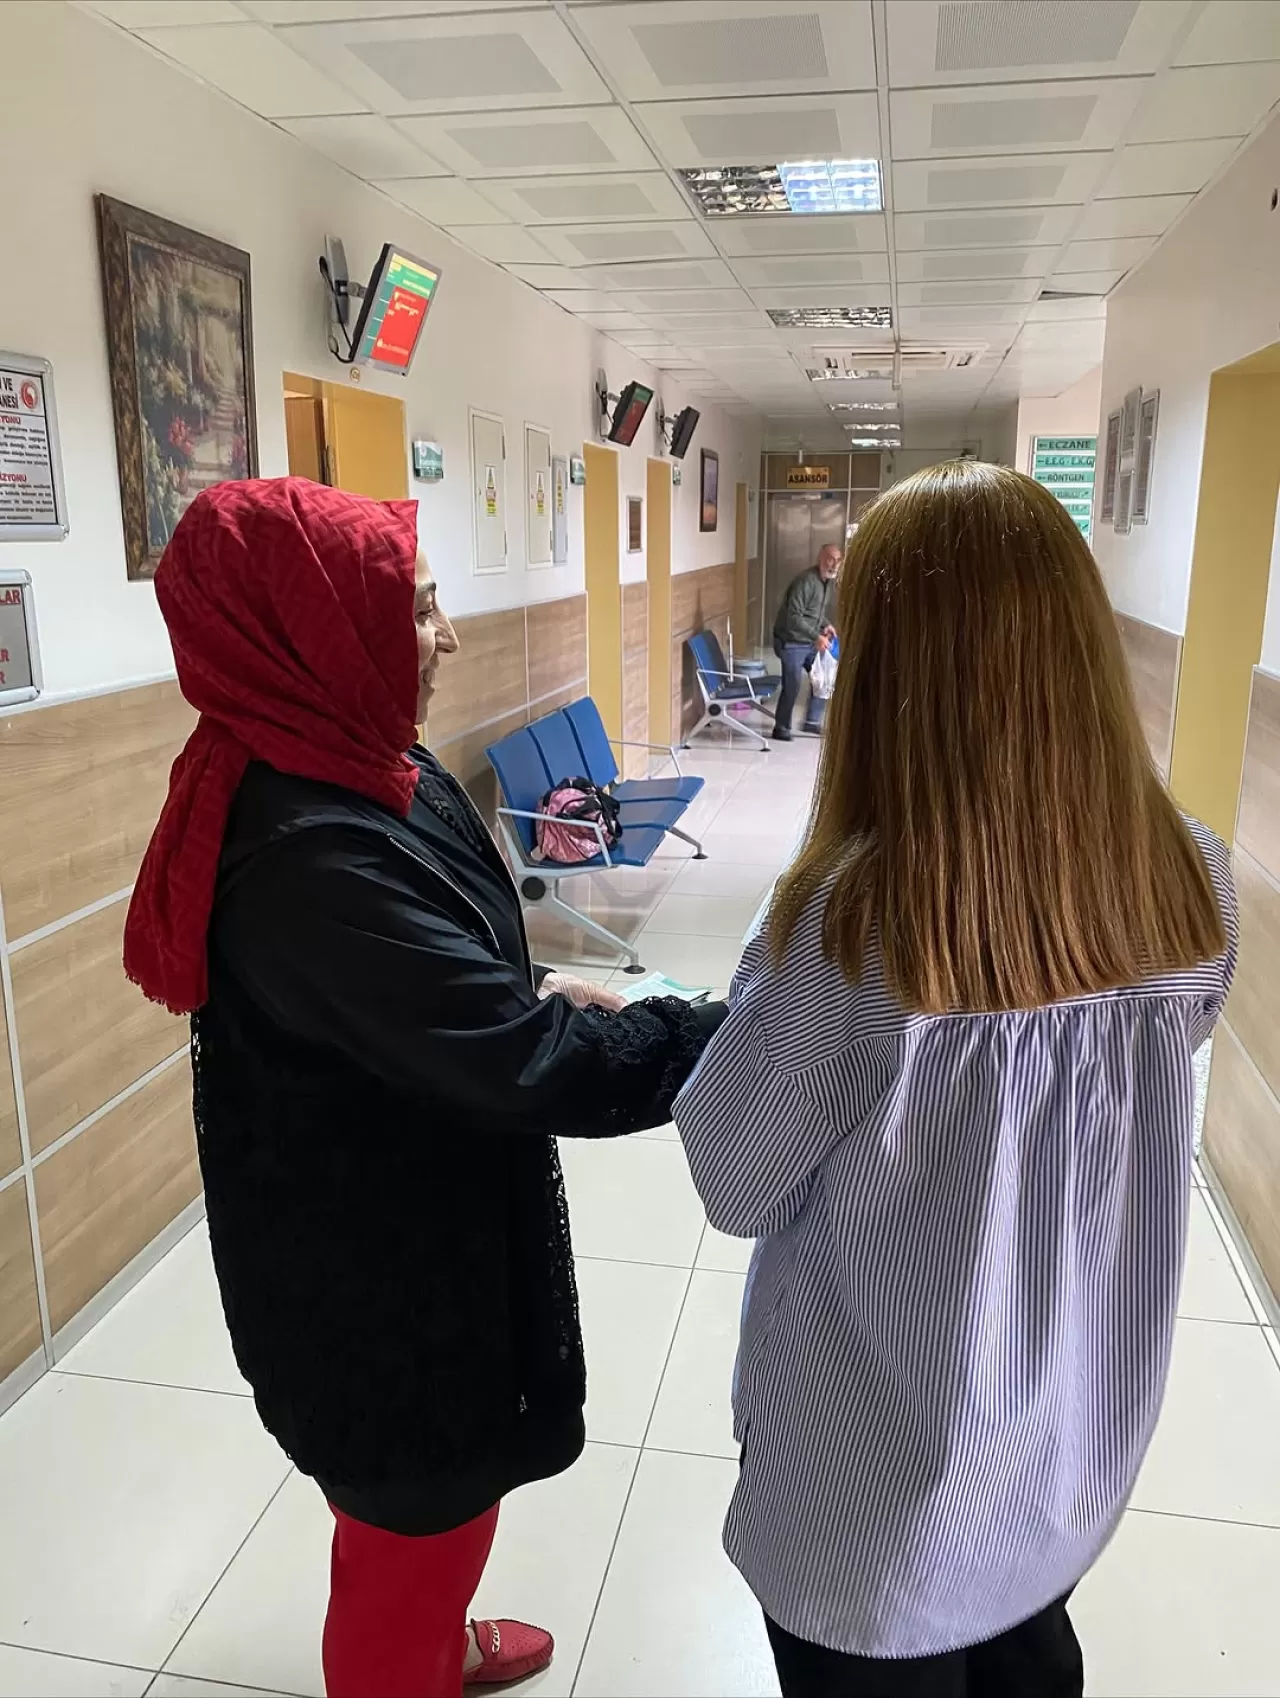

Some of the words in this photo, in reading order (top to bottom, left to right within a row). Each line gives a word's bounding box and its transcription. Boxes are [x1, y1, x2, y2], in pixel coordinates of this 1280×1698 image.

[2, 377, 13, 391] VE
[1049, 440, 1091, 449] ECZANE
[1047, 473, 1084, 482] RÖNTGEN
